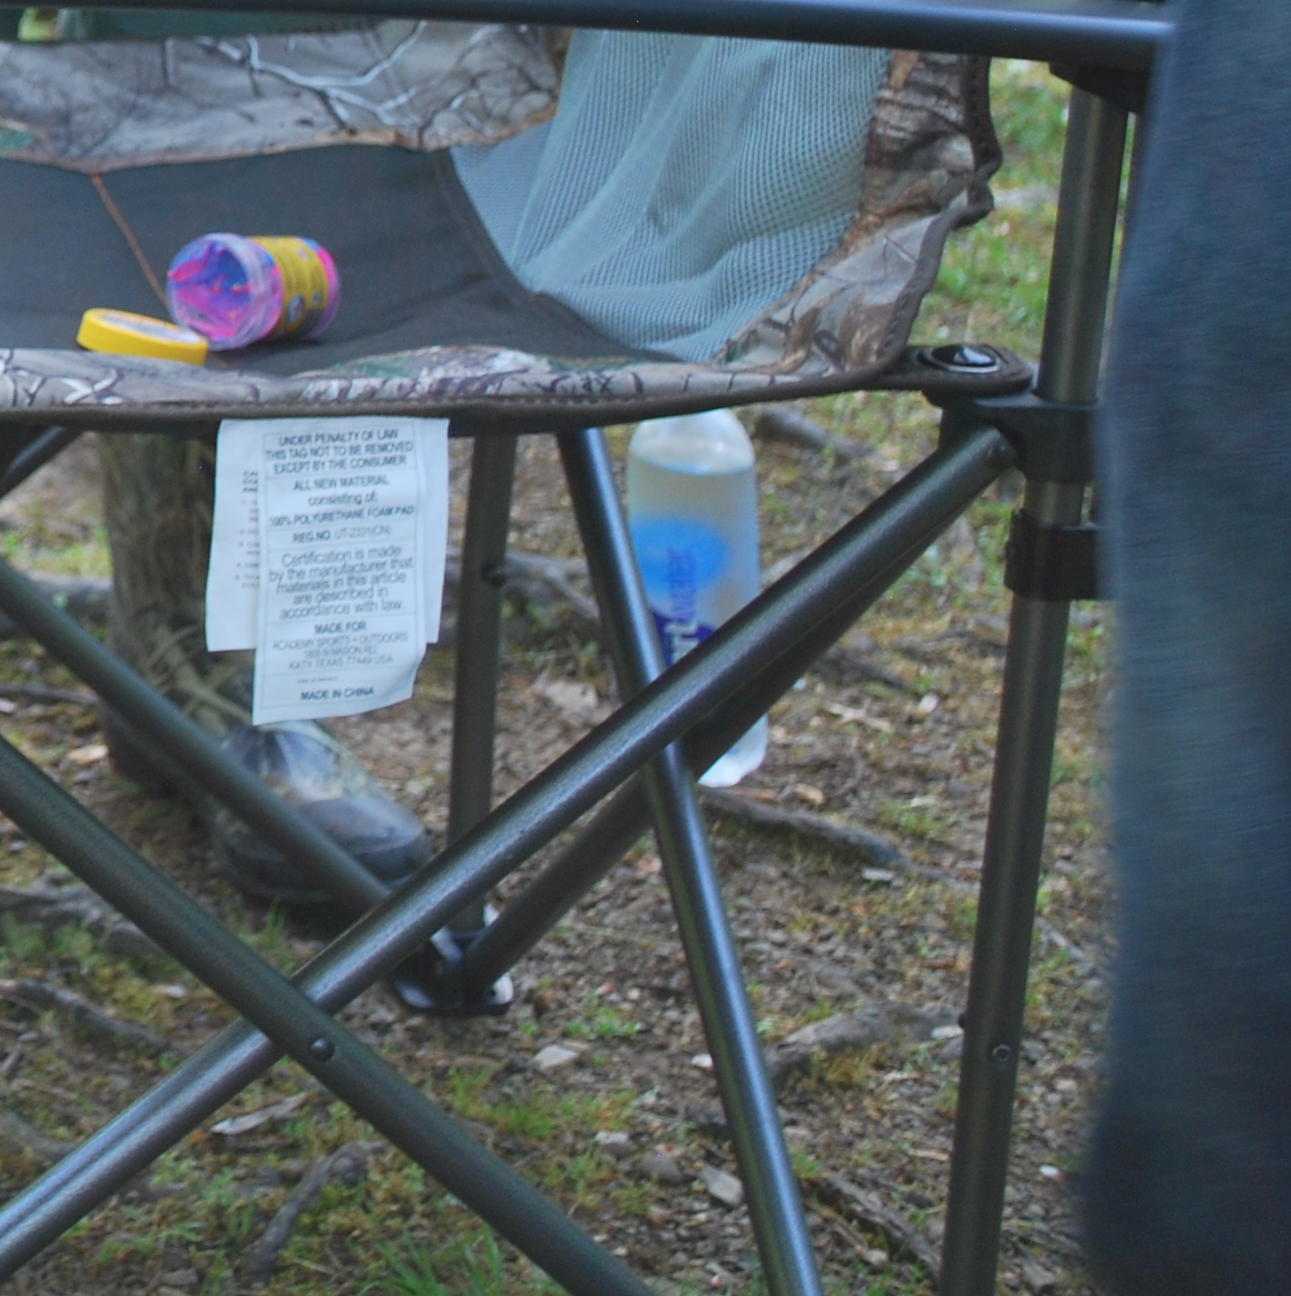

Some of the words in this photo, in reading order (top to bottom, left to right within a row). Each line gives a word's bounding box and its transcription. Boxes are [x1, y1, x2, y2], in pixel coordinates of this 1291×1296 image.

[279, 434, 311, 446] UNDER
[315, 432, 359, 444] PENALTY
[362, 430, 373, 441] OF
[378, 428, 398, 439] LAW
[266, 448, 286, 460] THIS
[289, 447, 307, 459] TAG
[310, 445, 330, 457] NOT
[334, 444, 346, 456] TO
[350, 444, 362, 455] BE
[365, 441, 413, 453] REMOVED
[274, 460, 310, 474] EXCEPT
[313, 459, 325, 471] BY
[329, 458, 346, 469] THE
[350, 455, 406, 468] CONSUMER
[294, 479, 311, 490] ALL
[314, 477, 337, 488] NEW
[340, 474, 389, 487] MATERIAL
[294, 509, 364, 524] POLYURETHANE
[368, 506, 393, 518] FOAM
[396, 505, 414, 515] PAD
[282, 550, 351, 567] Certification
[355, 547, 364, 560] is
[368, 543, 402, 559] made
[269, 570, 284, 582] by
[287, 568, 306, 579] the
[309, 560, 387, 578] manufacturer
[390, 557, 413, 568] that
[276, 578, 330, 594] materials
[333, 577, 344, 588] in
[347, 575, 366, 586] this
[370, 571, 406, 585] article
[293, 594, 312, 605] are
[315, 587, 374, 603] described
[377, 586, 388, 597] in
[280, 603, 350, 620] accordance
[354, 601, 378, 613] with
[314, 622, 342, 634] MADE
[346, 621, 366, 632] FOR
[300, 689, 328, 701] MADE
[332, 688, 341, 699] IN
[344, 686, 374, 699] CHINA
